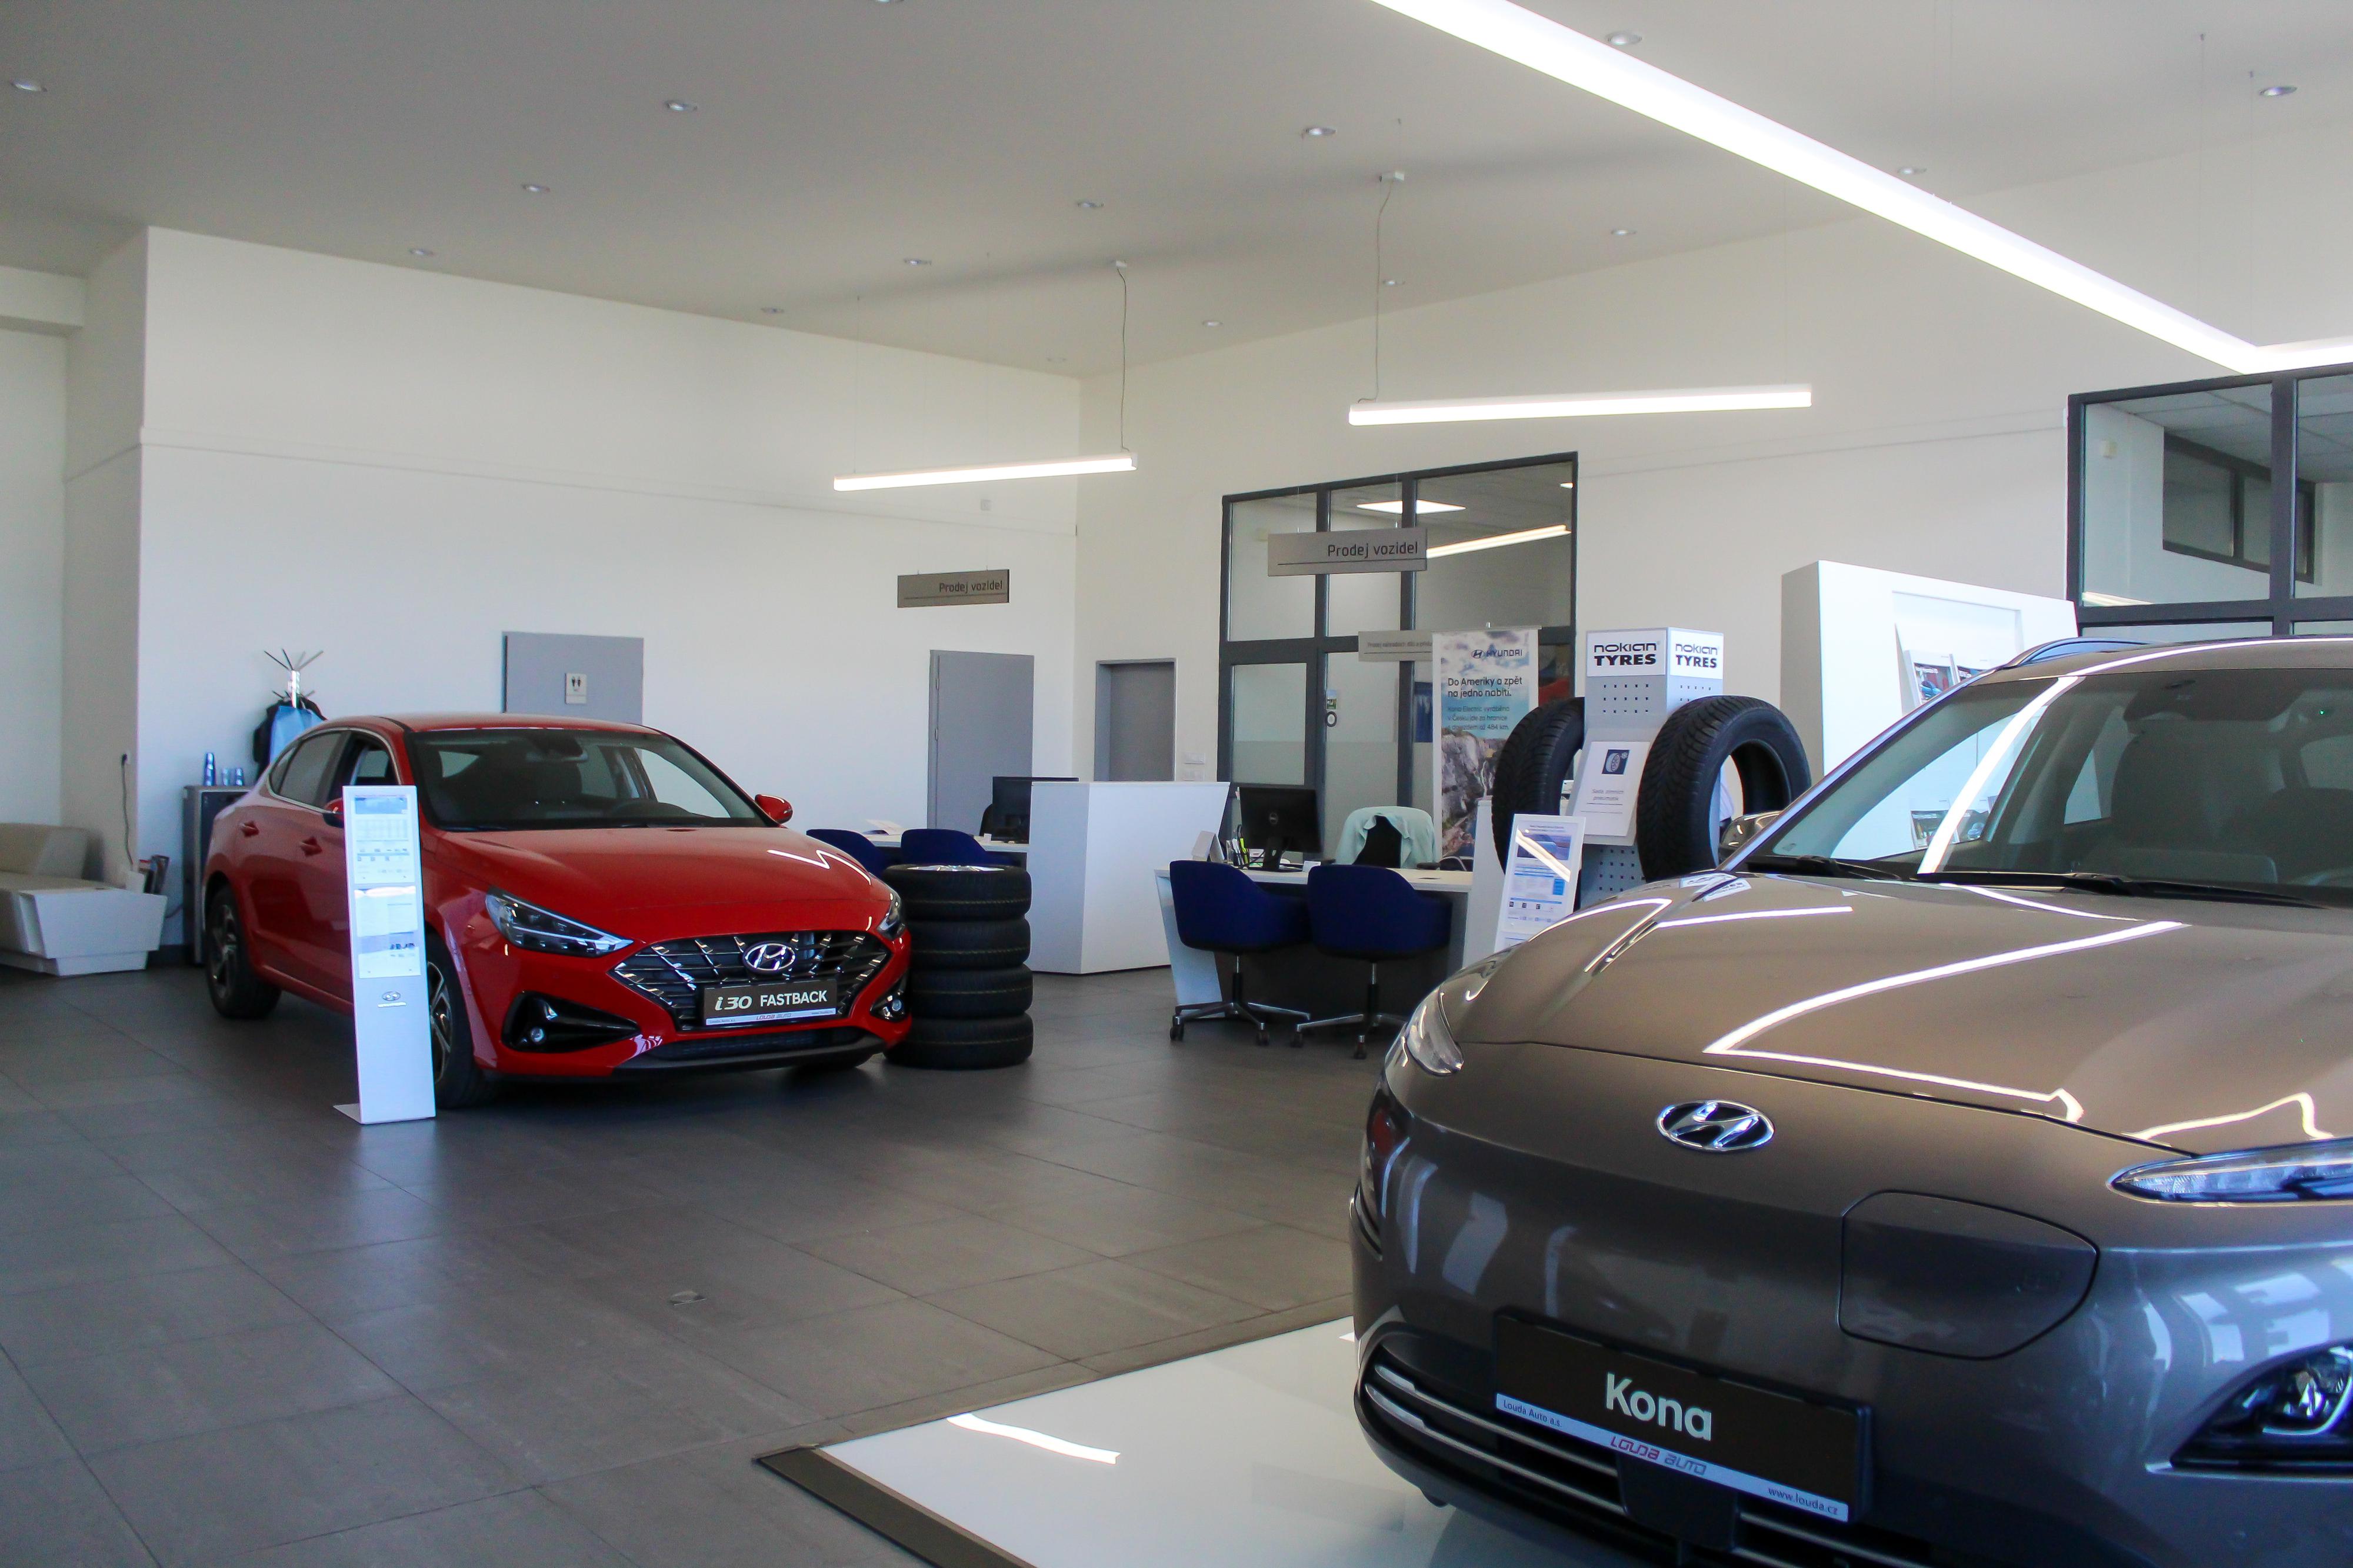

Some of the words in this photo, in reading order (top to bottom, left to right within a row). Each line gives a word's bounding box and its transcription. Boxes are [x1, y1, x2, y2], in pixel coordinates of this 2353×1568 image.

[1328, 543, 1369, 559] Prodej
[1373, 541, 1418, 556] vozidel
[939, 582, 968, 593] Prodej
[971, 580, 1002, 591] vozidel
[1594, 653, 1656, 666] TYRES
[1675, 655, 1717, 668] TYRES
[1448, 678, 1459, 686] Do
[1461, 676, 1495, 687] Ameriky
[1504, 676, 1522, 686] zpět
[1460, 689, 1483, 699] jedno
[715, 996, 752, 1011] i30
[760, 990, 828, 1007] FASTBACK
[1503, 1399, 1527, 1415] Louda
[1528, 1408, 1548, 1423] Auto
[1549, 1417, 1562, 1429] a.s.
[1605, 1371, 1712, 1442] Kona
[1768, 1487, 1838, 1515] www.louda.cz
